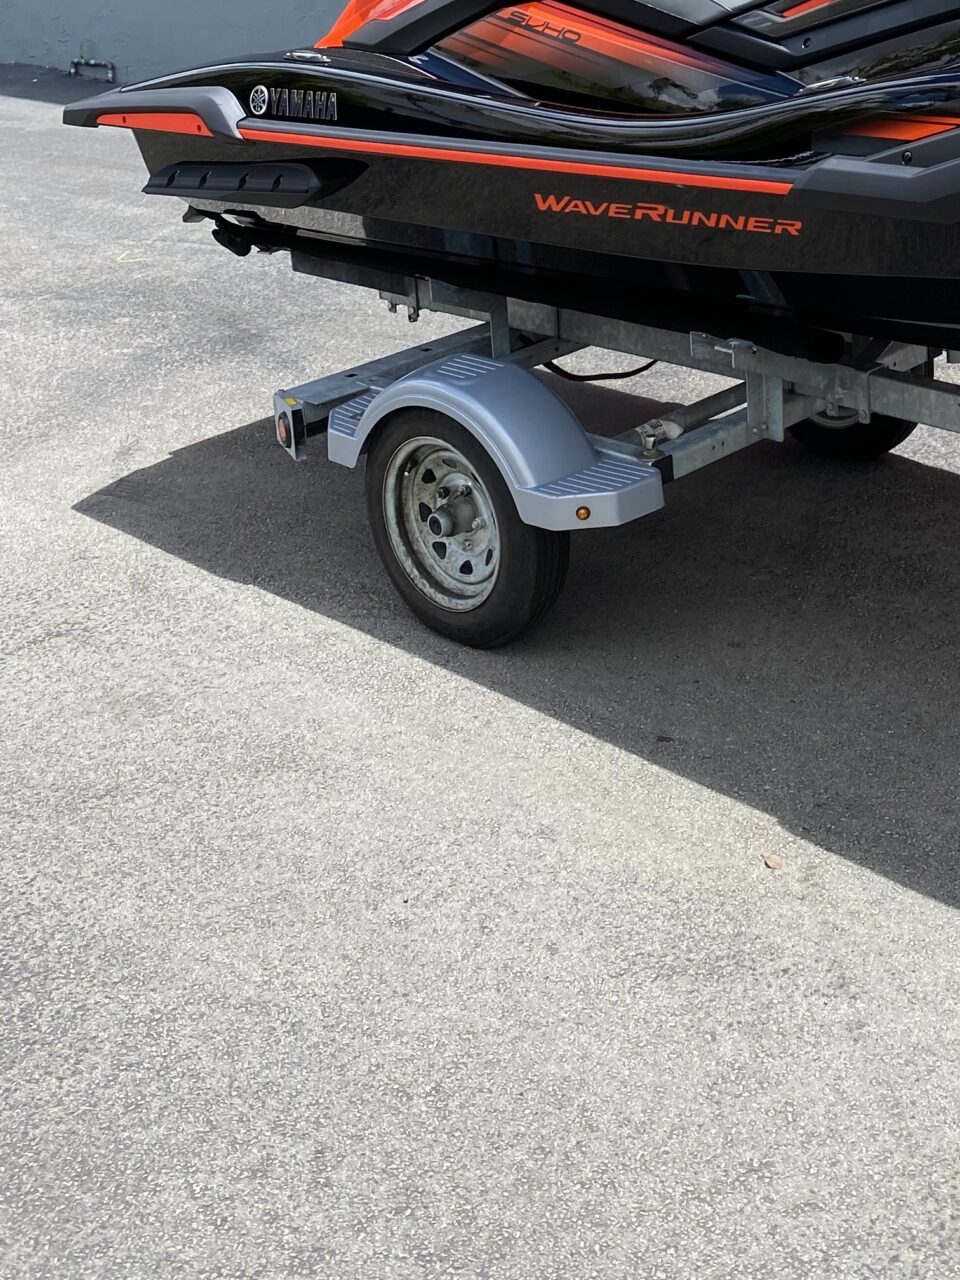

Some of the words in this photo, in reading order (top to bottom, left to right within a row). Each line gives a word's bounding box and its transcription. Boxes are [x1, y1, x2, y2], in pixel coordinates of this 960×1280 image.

[508, 9, 582, 44] SVHO
[270, 87, 338, 121] YAMAHA
[534, 193, 802, 237] WAVERUNNER
